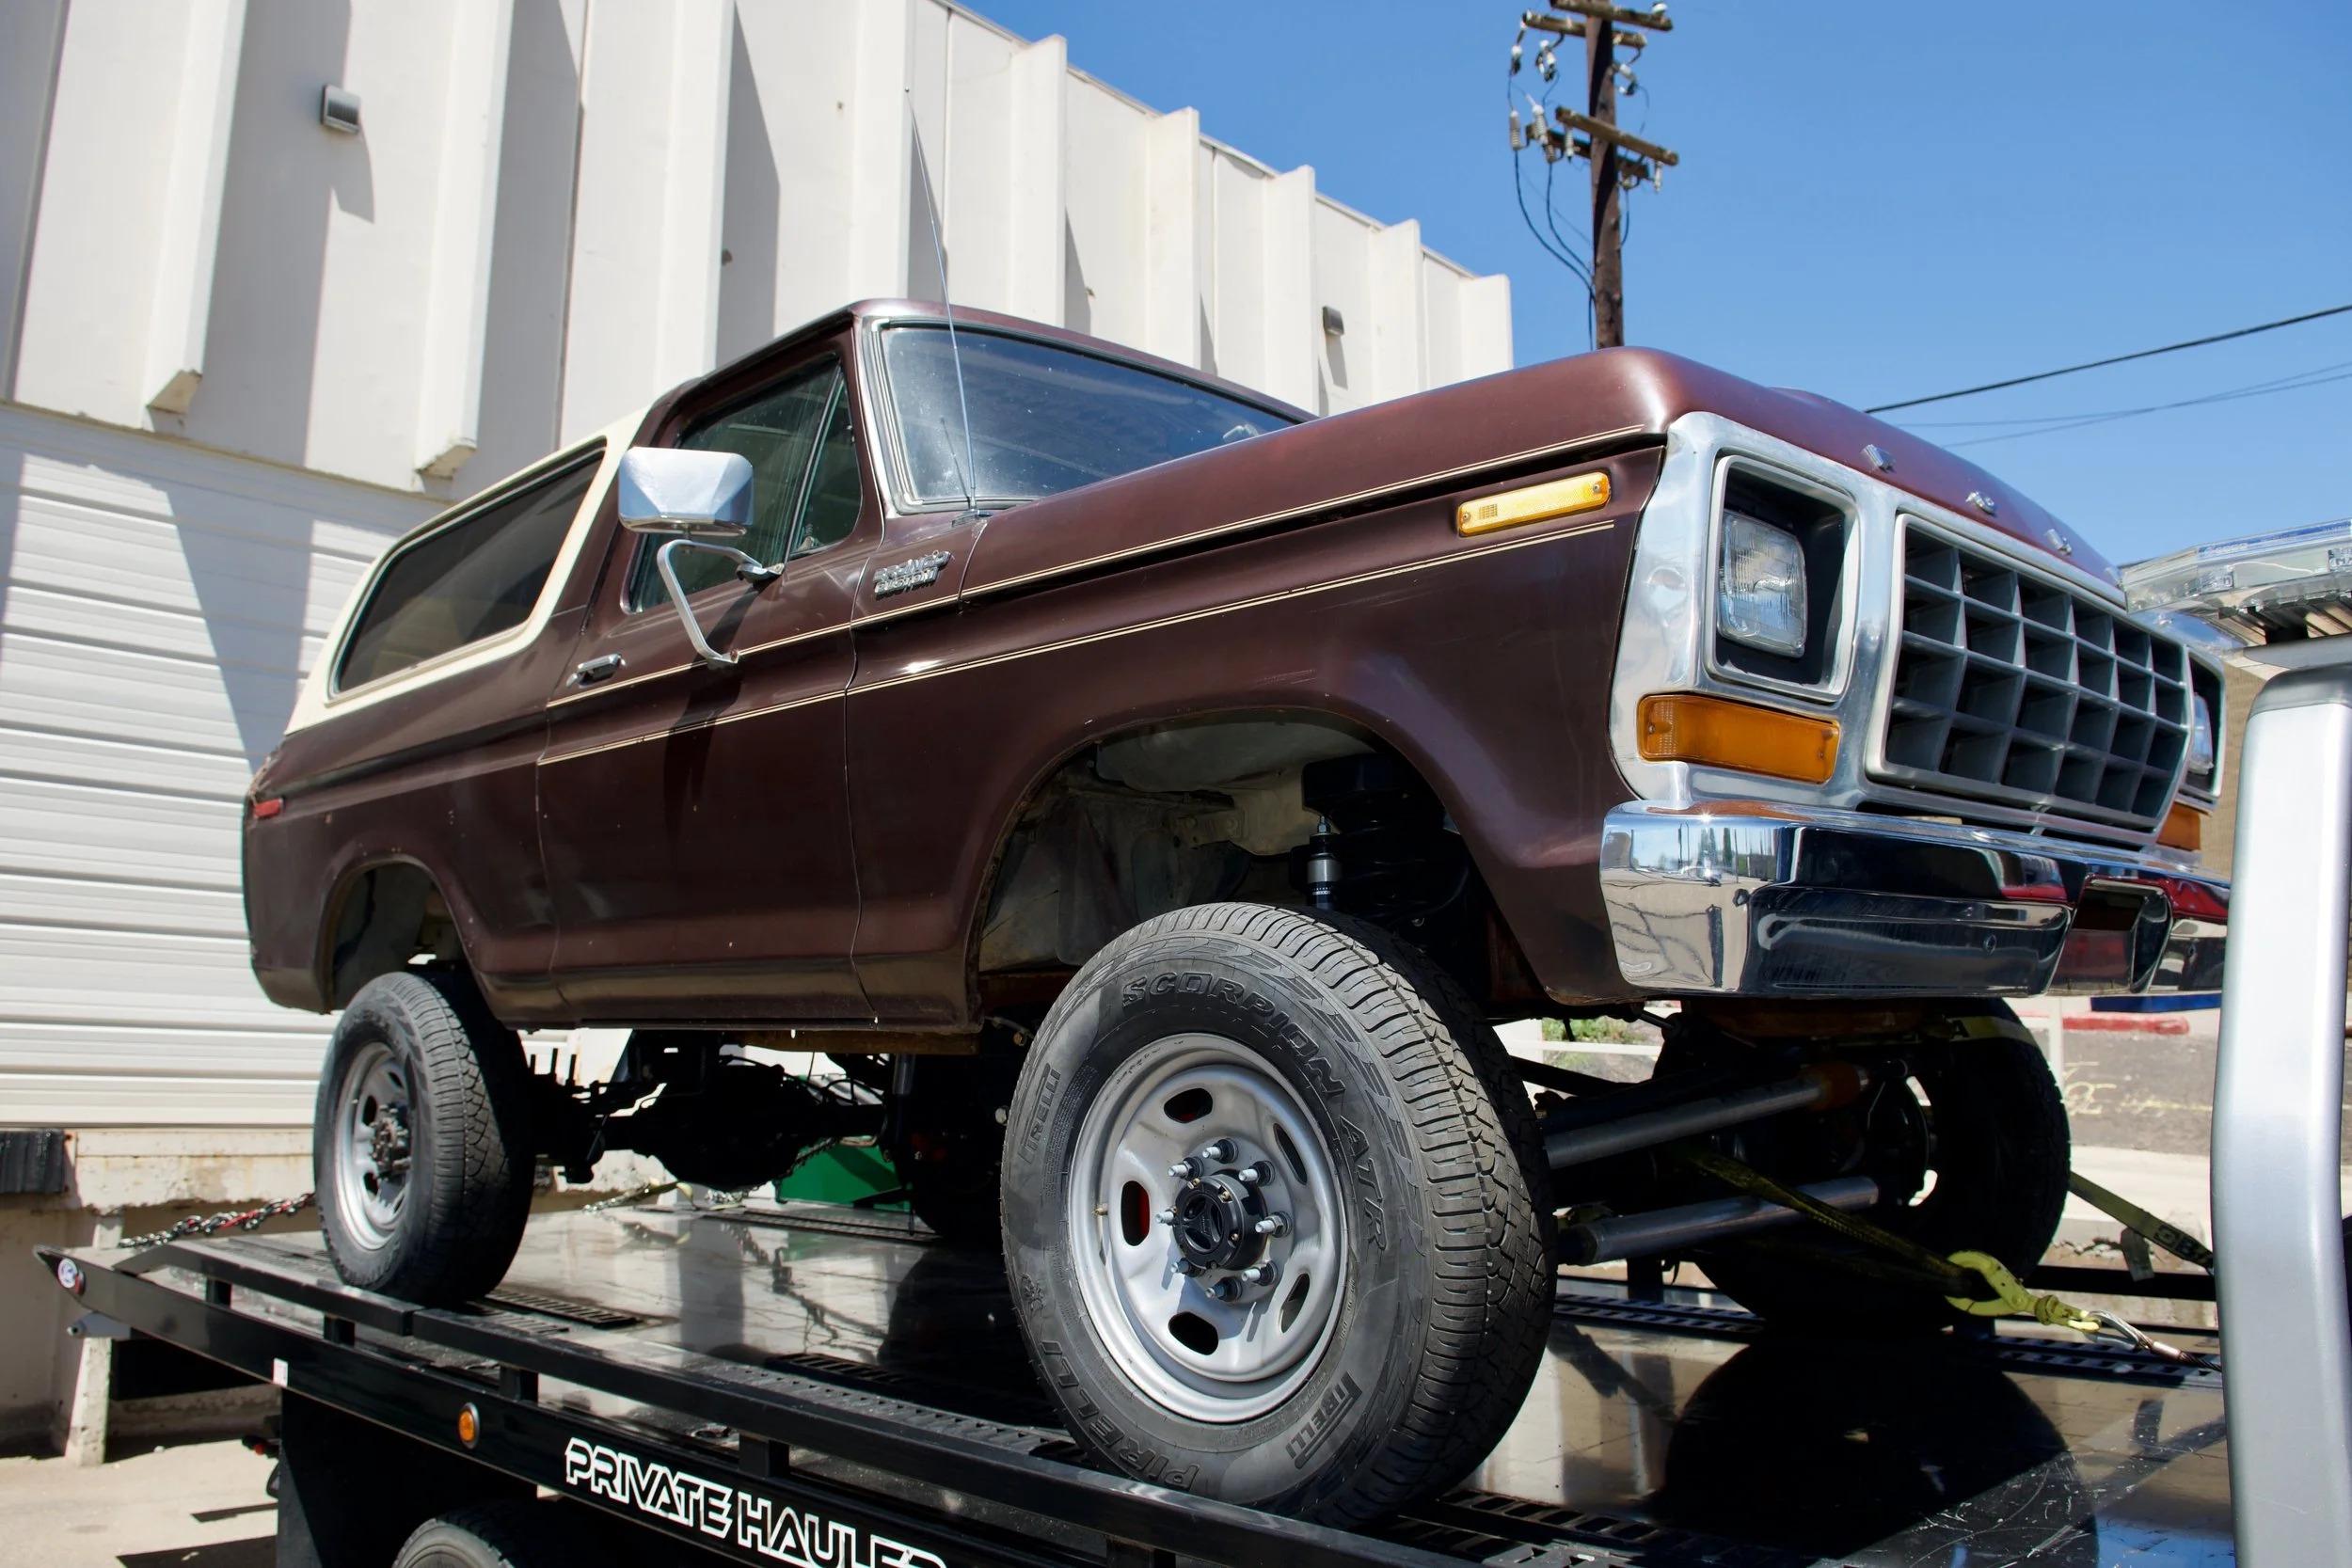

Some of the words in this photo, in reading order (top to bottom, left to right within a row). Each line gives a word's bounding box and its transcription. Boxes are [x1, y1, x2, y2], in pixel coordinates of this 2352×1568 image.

[1017, 1062, 1061, 1165] PIRELLI
[1121, 971, 1346, 1095] SCORPION
[1339, 1116, 1388, 1252] ATR
[1040, 1340, 1200, 1492] PIRELLI
[1285, 1370, 1363, 1470] PIRELLI
[565, 1437, 734, 1539] PRIVATE
